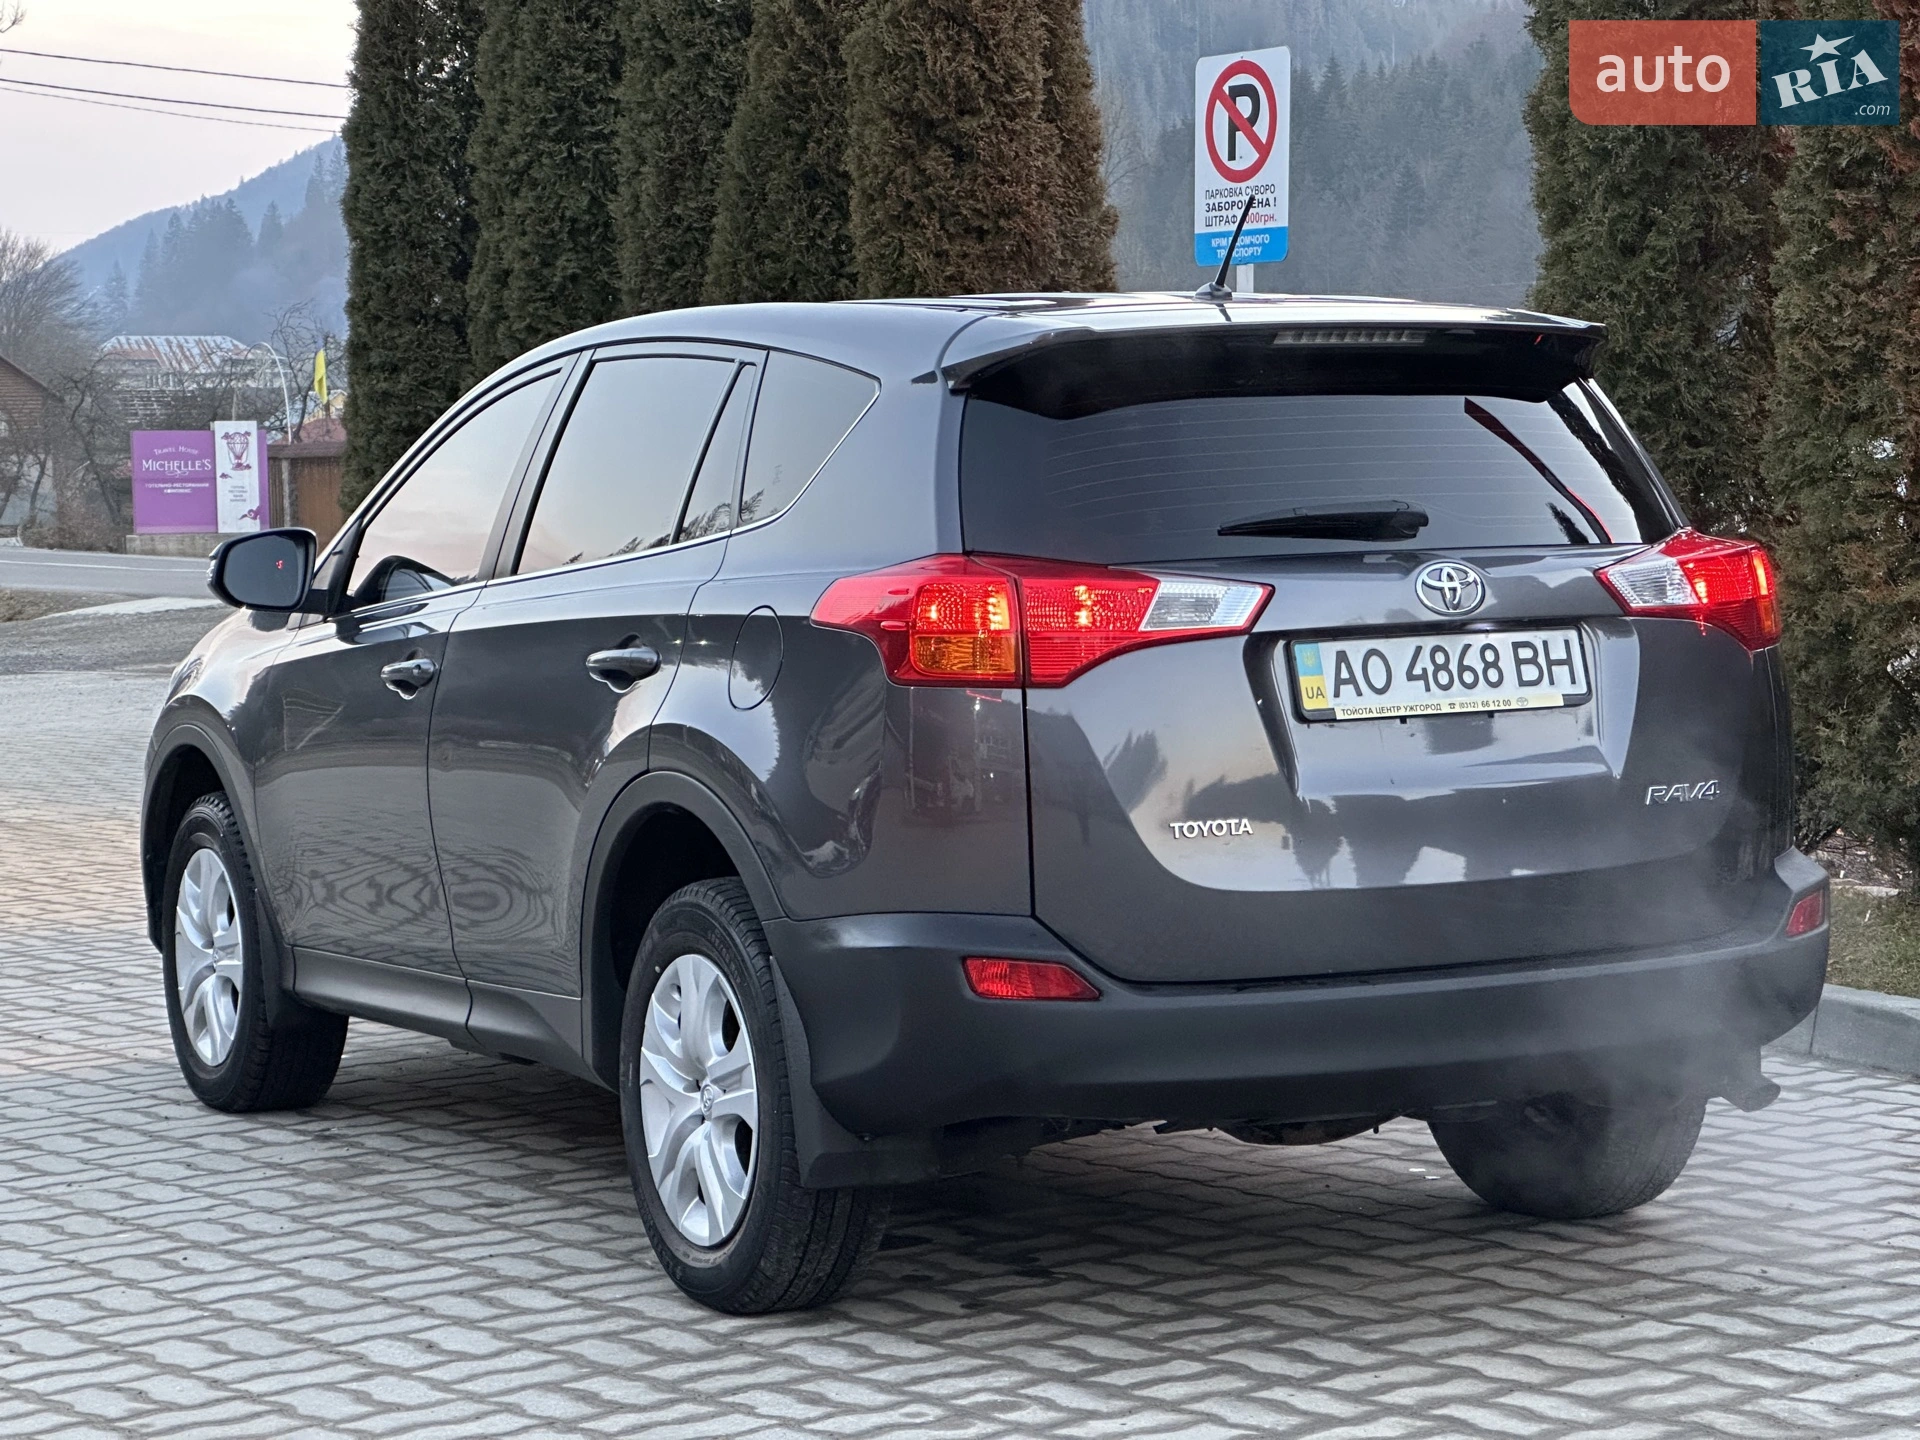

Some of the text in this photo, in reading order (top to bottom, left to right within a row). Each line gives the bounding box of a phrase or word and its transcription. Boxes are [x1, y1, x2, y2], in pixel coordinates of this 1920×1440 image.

[1205, 184, 1276, 200] ПАРКОВКА СУВОРО
[1205, 198, 1271, 213] ЗАБОРОЕНА
[1205, 212, 1277, 227] ШТРАФ 000грн.
[1211, 234, 1270, 248] КРІМ ДОМЧОГО
[1217, 246, 1262, 259] ТРСПОРТУ
[1333, 639, 1577, 698] AO 4868 BH
[1305, 686, 1325, 699] UA
[1341, 699, 1512, 717] ТОЙОТА ЦЕНТР УЖГОРОД (0312) 66 12 00
[1645, 779, 1720, 806] RAV4
[1169, 818, 1254, 839] TOYOTA
